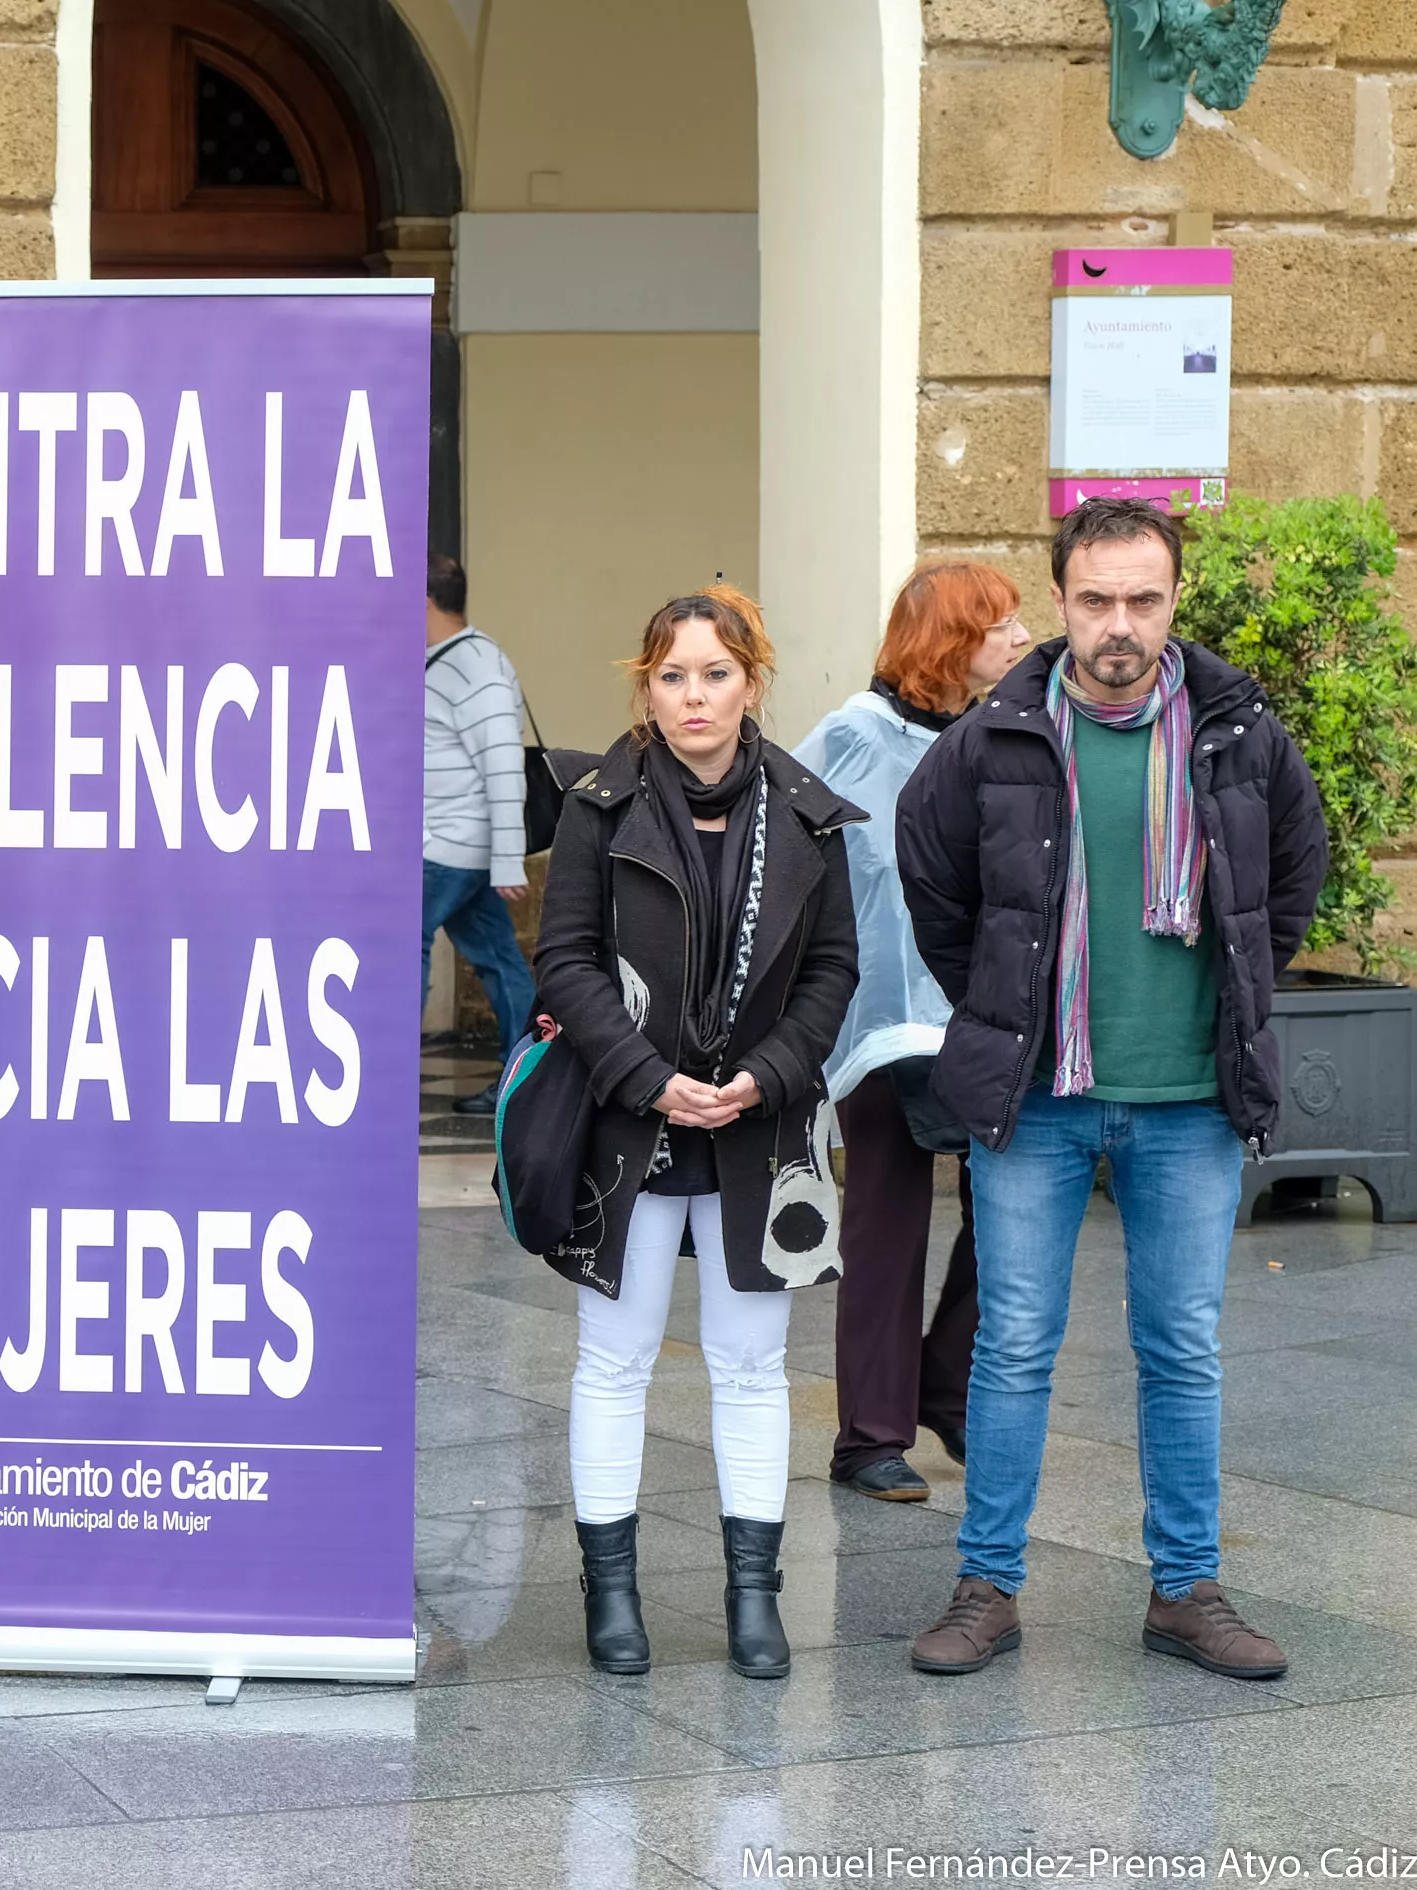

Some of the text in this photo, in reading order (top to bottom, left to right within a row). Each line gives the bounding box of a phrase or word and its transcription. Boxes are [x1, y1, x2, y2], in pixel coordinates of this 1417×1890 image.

[1083, 320, 1172, 335] Ayuntamiento
[263, 390, 393, 577] LA
[170, 938, 360, 1126] LAS
[121, 1459, 162, 1498] de
[170, 1460, 269, 1502] Cádiz
[33, 1508, 113, 1533] Municipal
[117, 1509, 139, 1530] de
[143, 1510, 159, 1531] la
[162, 1511, 211, 1536] Mujer
